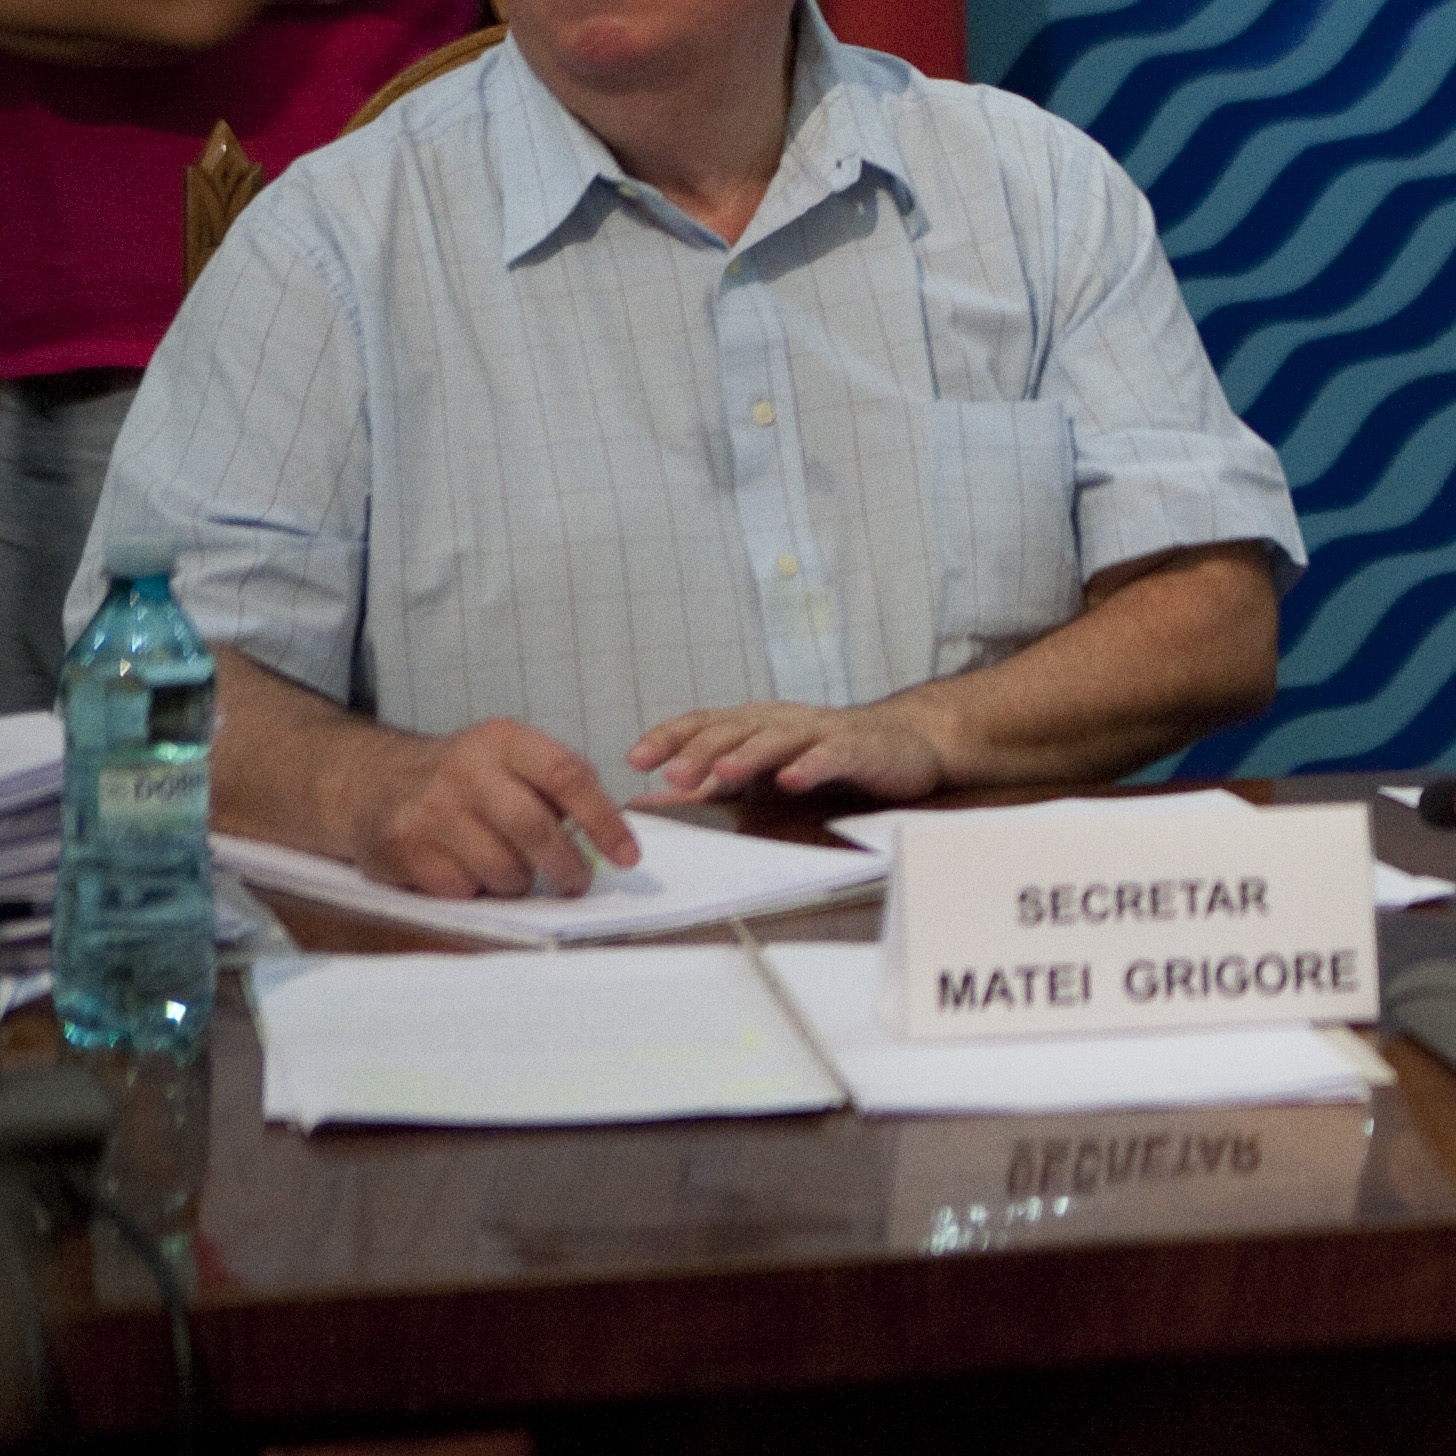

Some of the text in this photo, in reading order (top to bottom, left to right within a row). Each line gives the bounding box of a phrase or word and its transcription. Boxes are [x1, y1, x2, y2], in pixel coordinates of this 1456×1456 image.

[1016, 877, 1269, 927] SECRETAR
[937, 949, 1359, 1013] MATEI GRIGORE
